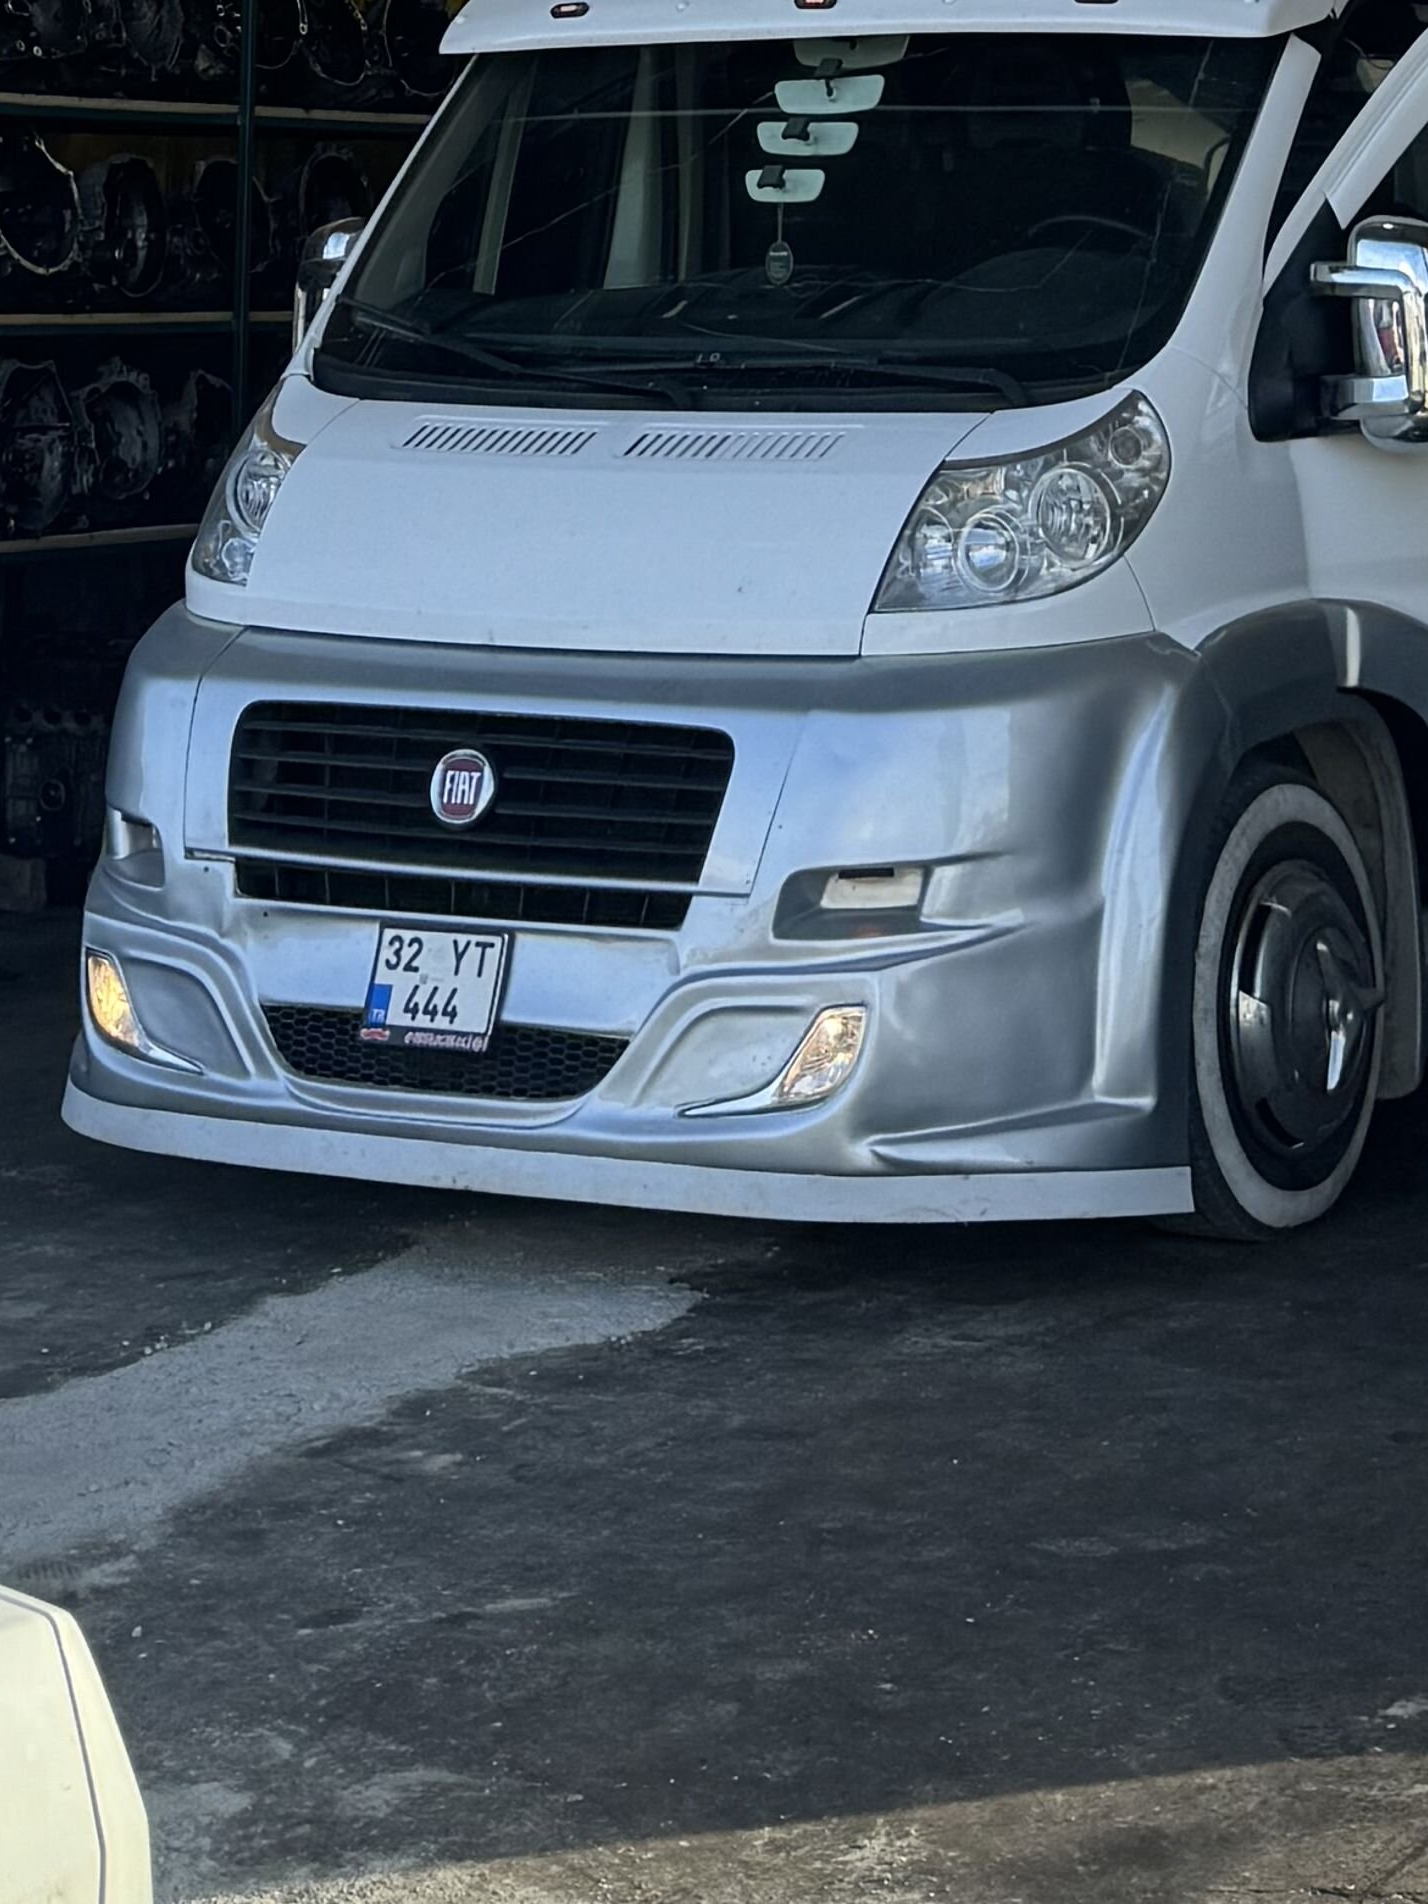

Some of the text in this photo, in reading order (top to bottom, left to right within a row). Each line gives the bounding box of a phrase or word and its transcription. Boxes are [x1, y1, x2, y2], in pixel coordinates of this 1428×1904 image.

[442, 769, 482, 805] FIAT
[384, 934, 496, 979] 32 YT
[402, 984, 458, 1025] 444
